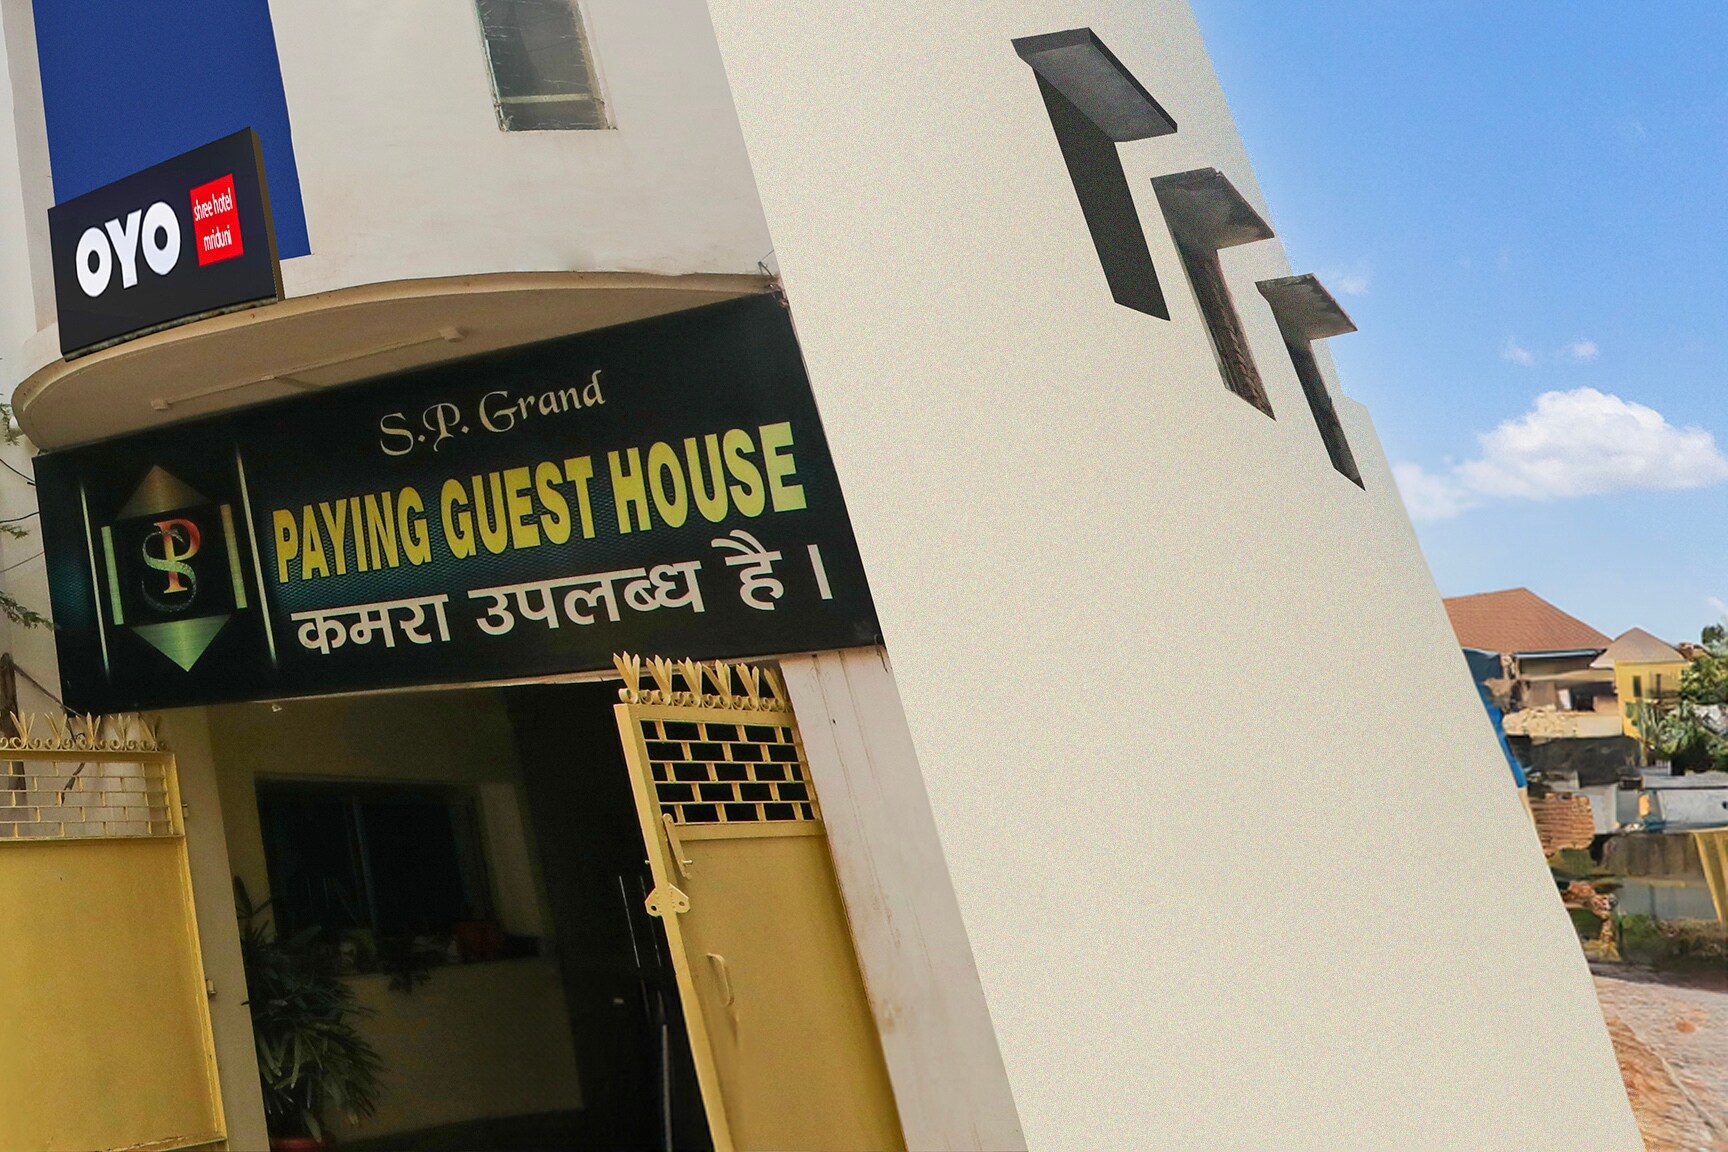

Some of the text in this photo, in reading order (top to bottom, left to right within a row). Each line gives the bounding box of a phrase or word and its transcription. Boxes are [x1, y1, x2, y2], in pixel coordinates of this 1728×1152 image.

[76, 201, 181, 298] OYO
[194, 187, 233, 222] shree hotel
[380, 370, 607, 457] S.P. Grand
[272, 421, 808, 584] PAYING GUEST HOUSE
[291, 594, 451, 655] कमरा
[467, 560, 706, 637] उपलब्ध
